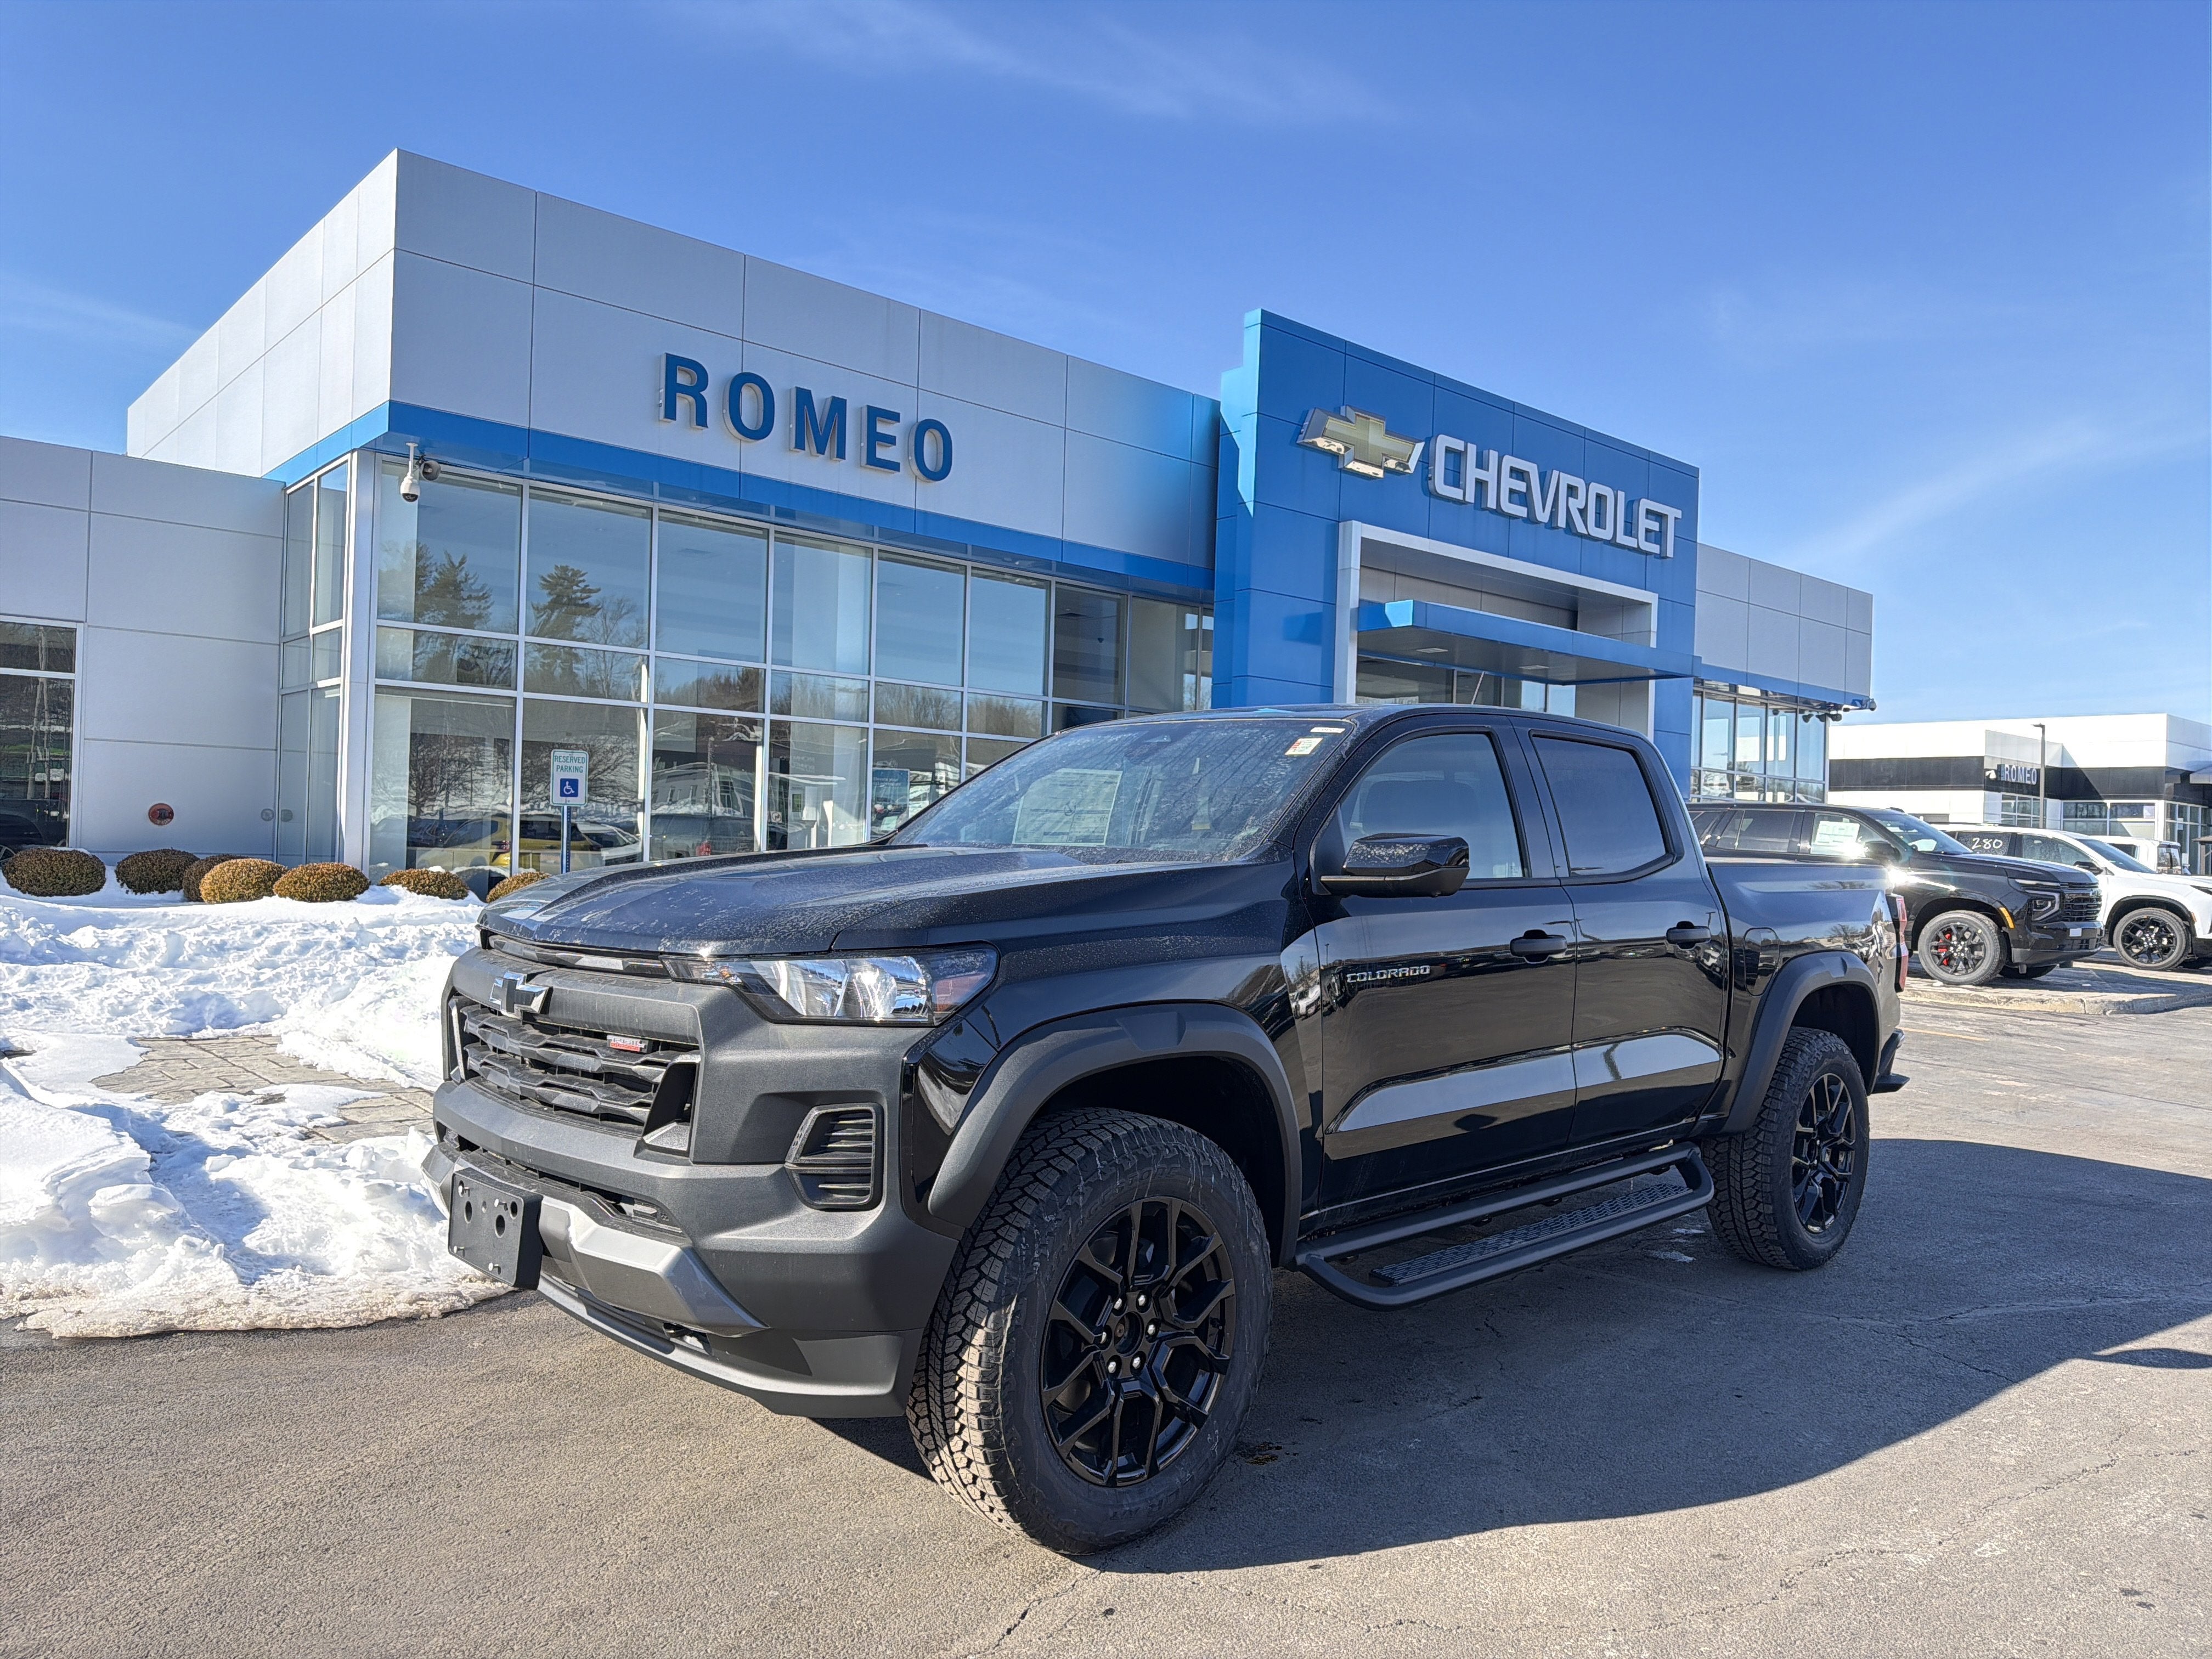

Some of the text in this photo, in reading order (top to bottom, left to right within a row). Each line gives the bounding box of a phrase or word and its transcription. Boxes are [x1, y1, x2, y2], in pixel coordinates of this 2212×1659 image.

[660, 353, 952, 482] ROMEO
[1430, 434, 1682, 558] CHEVROLET
[554, 755, 585, 764] RESERVED
[2005, 764, 2037, 785] ROMEO
[1971, 837, 2003, 850] 280
[1346, 965, 1430, 983] COLORADO
